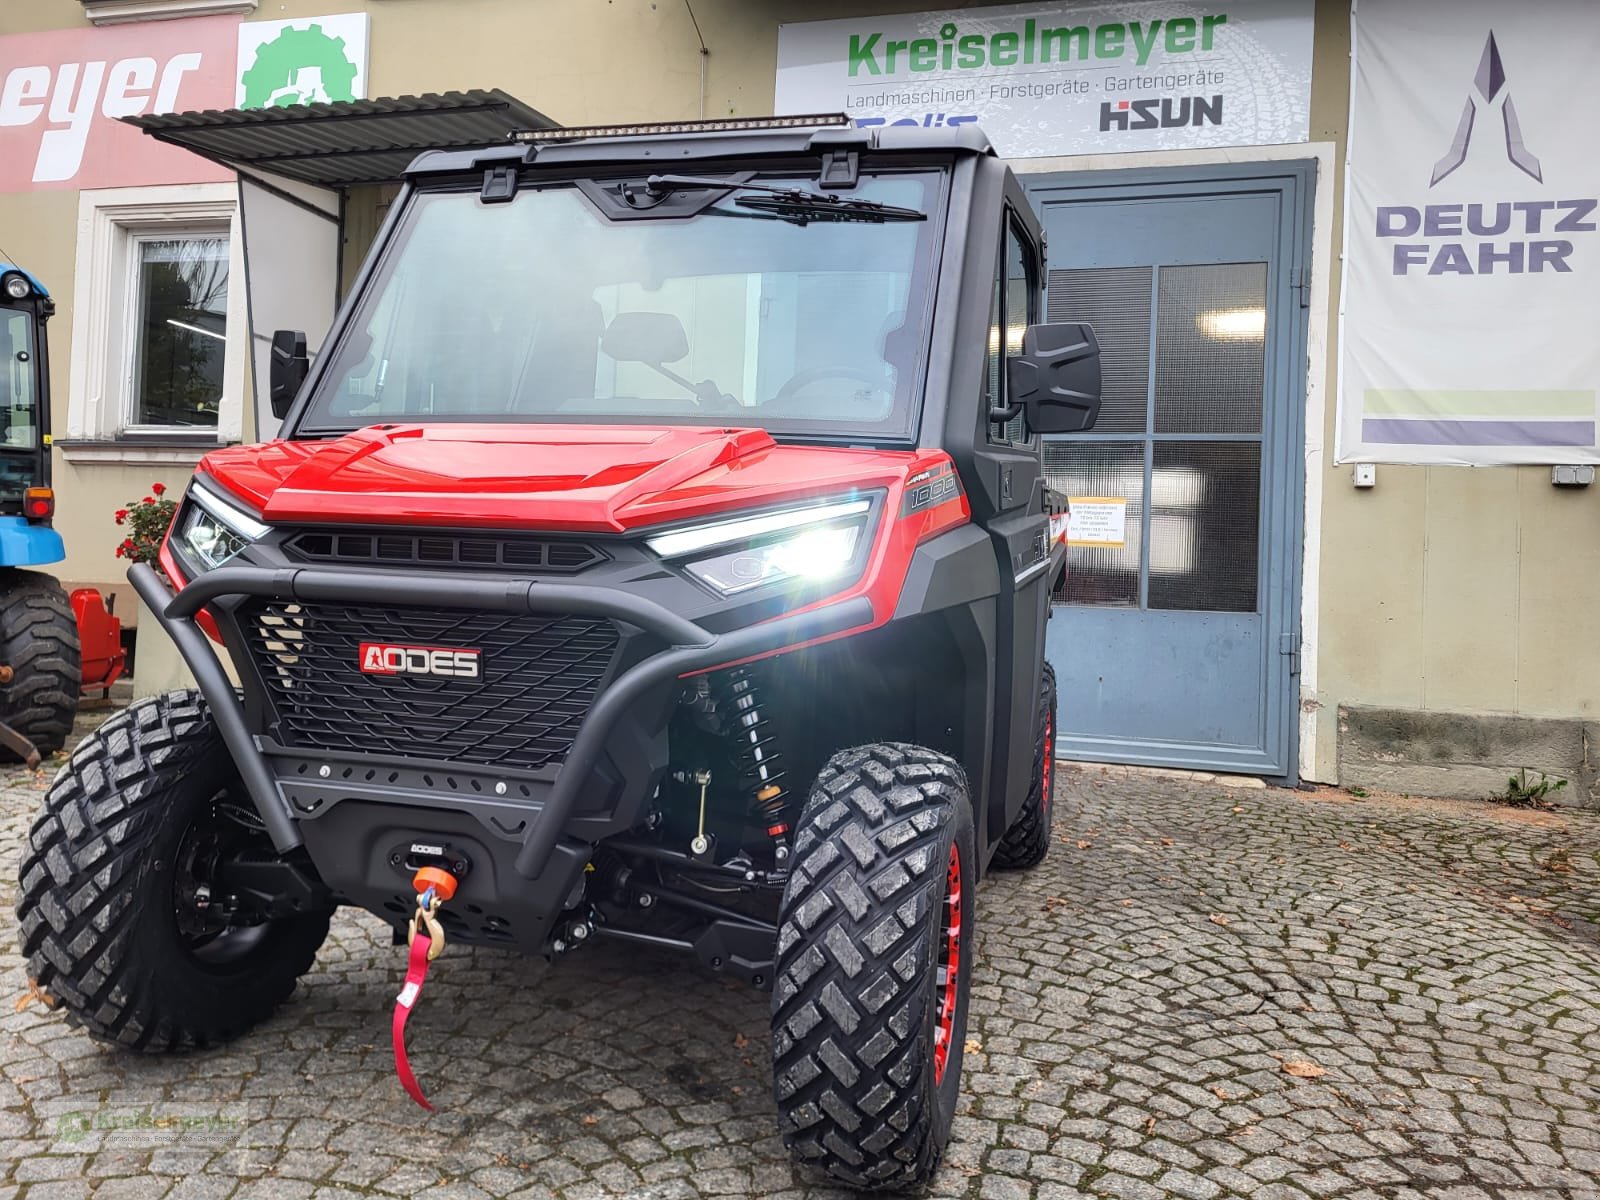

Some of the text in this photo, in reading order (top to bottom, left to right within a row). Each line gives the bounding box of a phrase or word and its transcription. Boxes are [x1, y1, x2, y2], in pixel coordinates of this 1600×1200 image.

[848, 14, 1227, 76] Kreiselmeyer
[846, 71, 1224, 108] Landmaschinen Forstgeräte Gartengeräte
[1376, 199, 1598, 237] DEUTZ
[1393, 240, 1574, 276] FAHR
[363, 646, 479, 678] AODES
